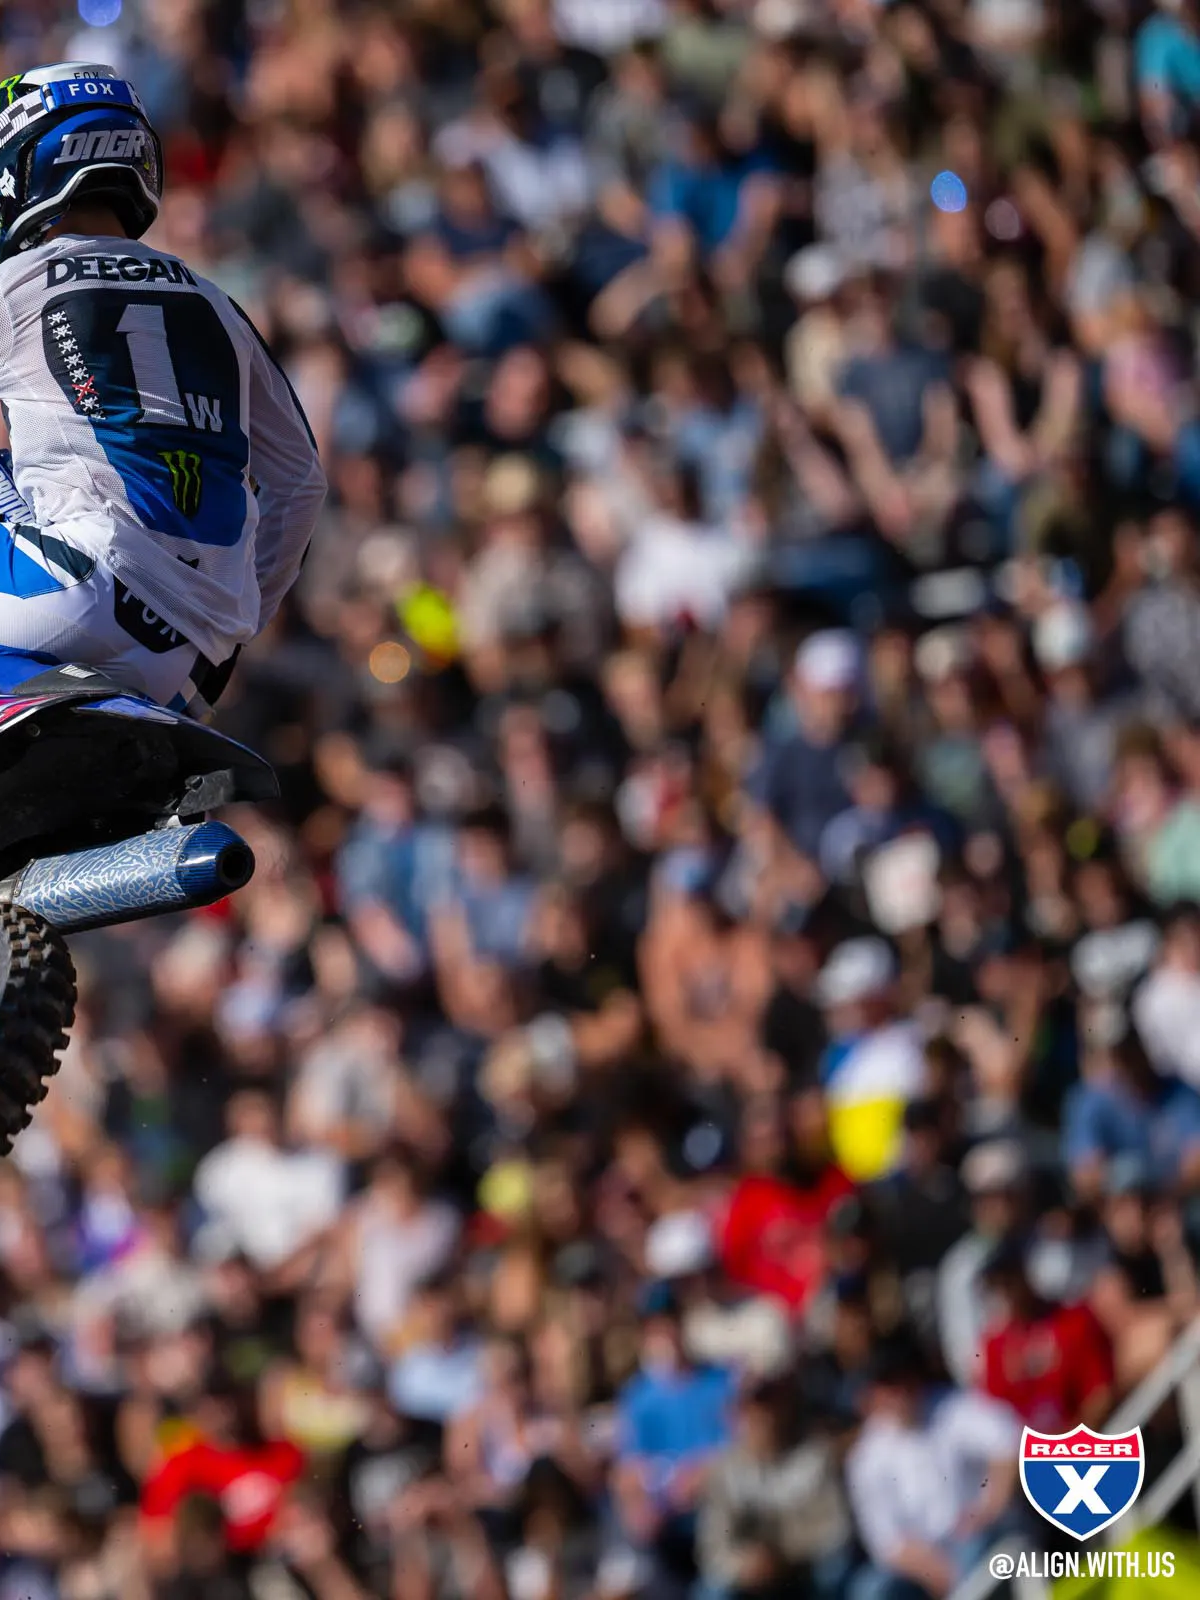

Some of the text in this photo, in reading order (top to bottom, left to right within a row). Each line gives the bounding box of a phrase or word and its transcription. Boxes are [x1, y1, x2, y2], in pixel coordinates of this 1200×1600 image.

[68, 82, 114, 96] FOX
[53, 129, 145, 165] DNGR
[43, 256, 198, 290] DEEGAN
